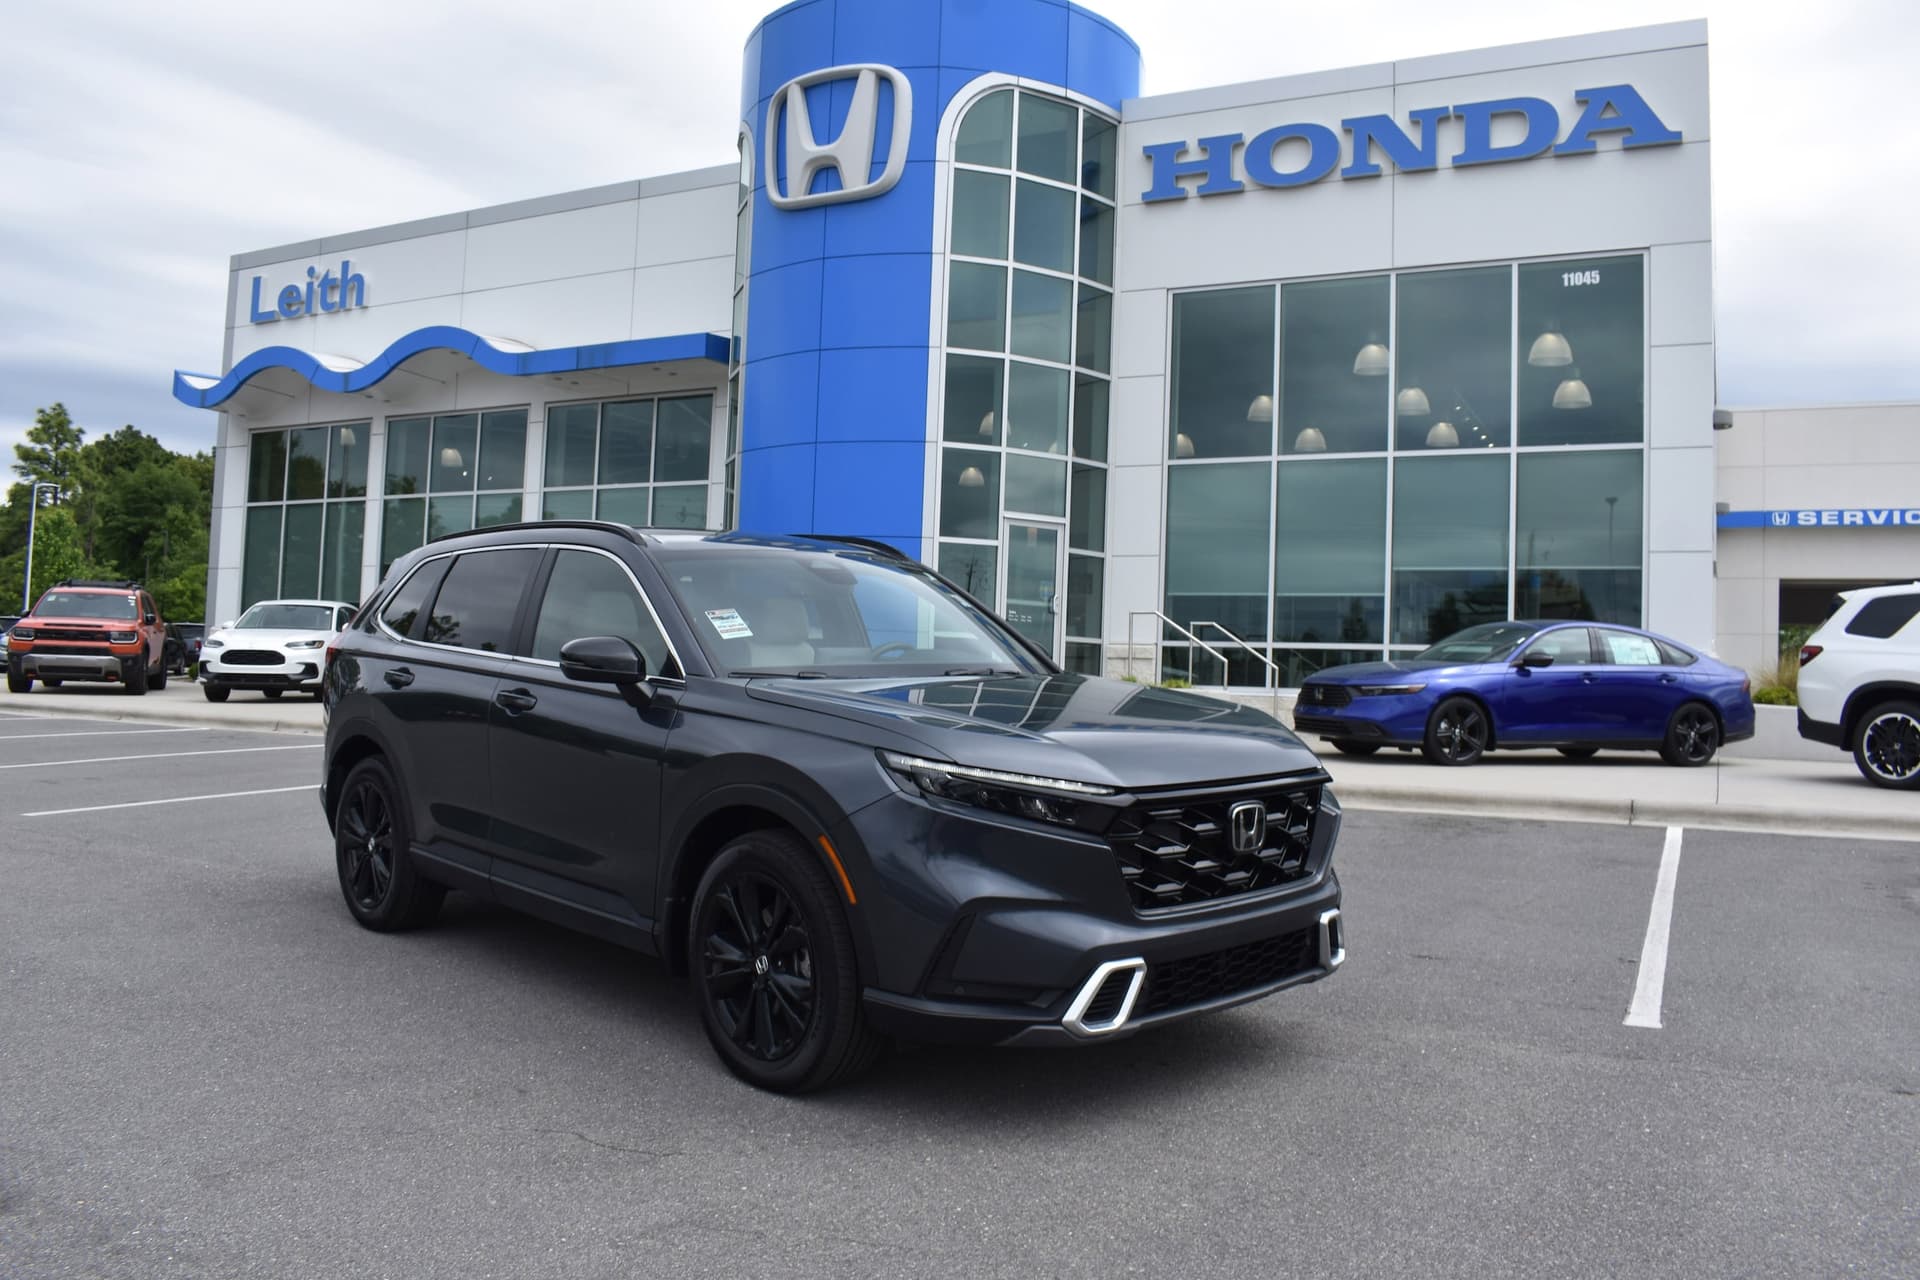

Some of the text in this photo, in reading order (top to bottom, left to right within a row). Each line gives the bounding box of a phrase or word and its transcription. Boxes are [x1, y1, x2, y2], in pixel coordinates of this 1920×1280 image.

[1142, 84, 1682, 201] HONDA
[250, 260, 366, 323] Leith
[1561, 270, 1600, 287] 11045
